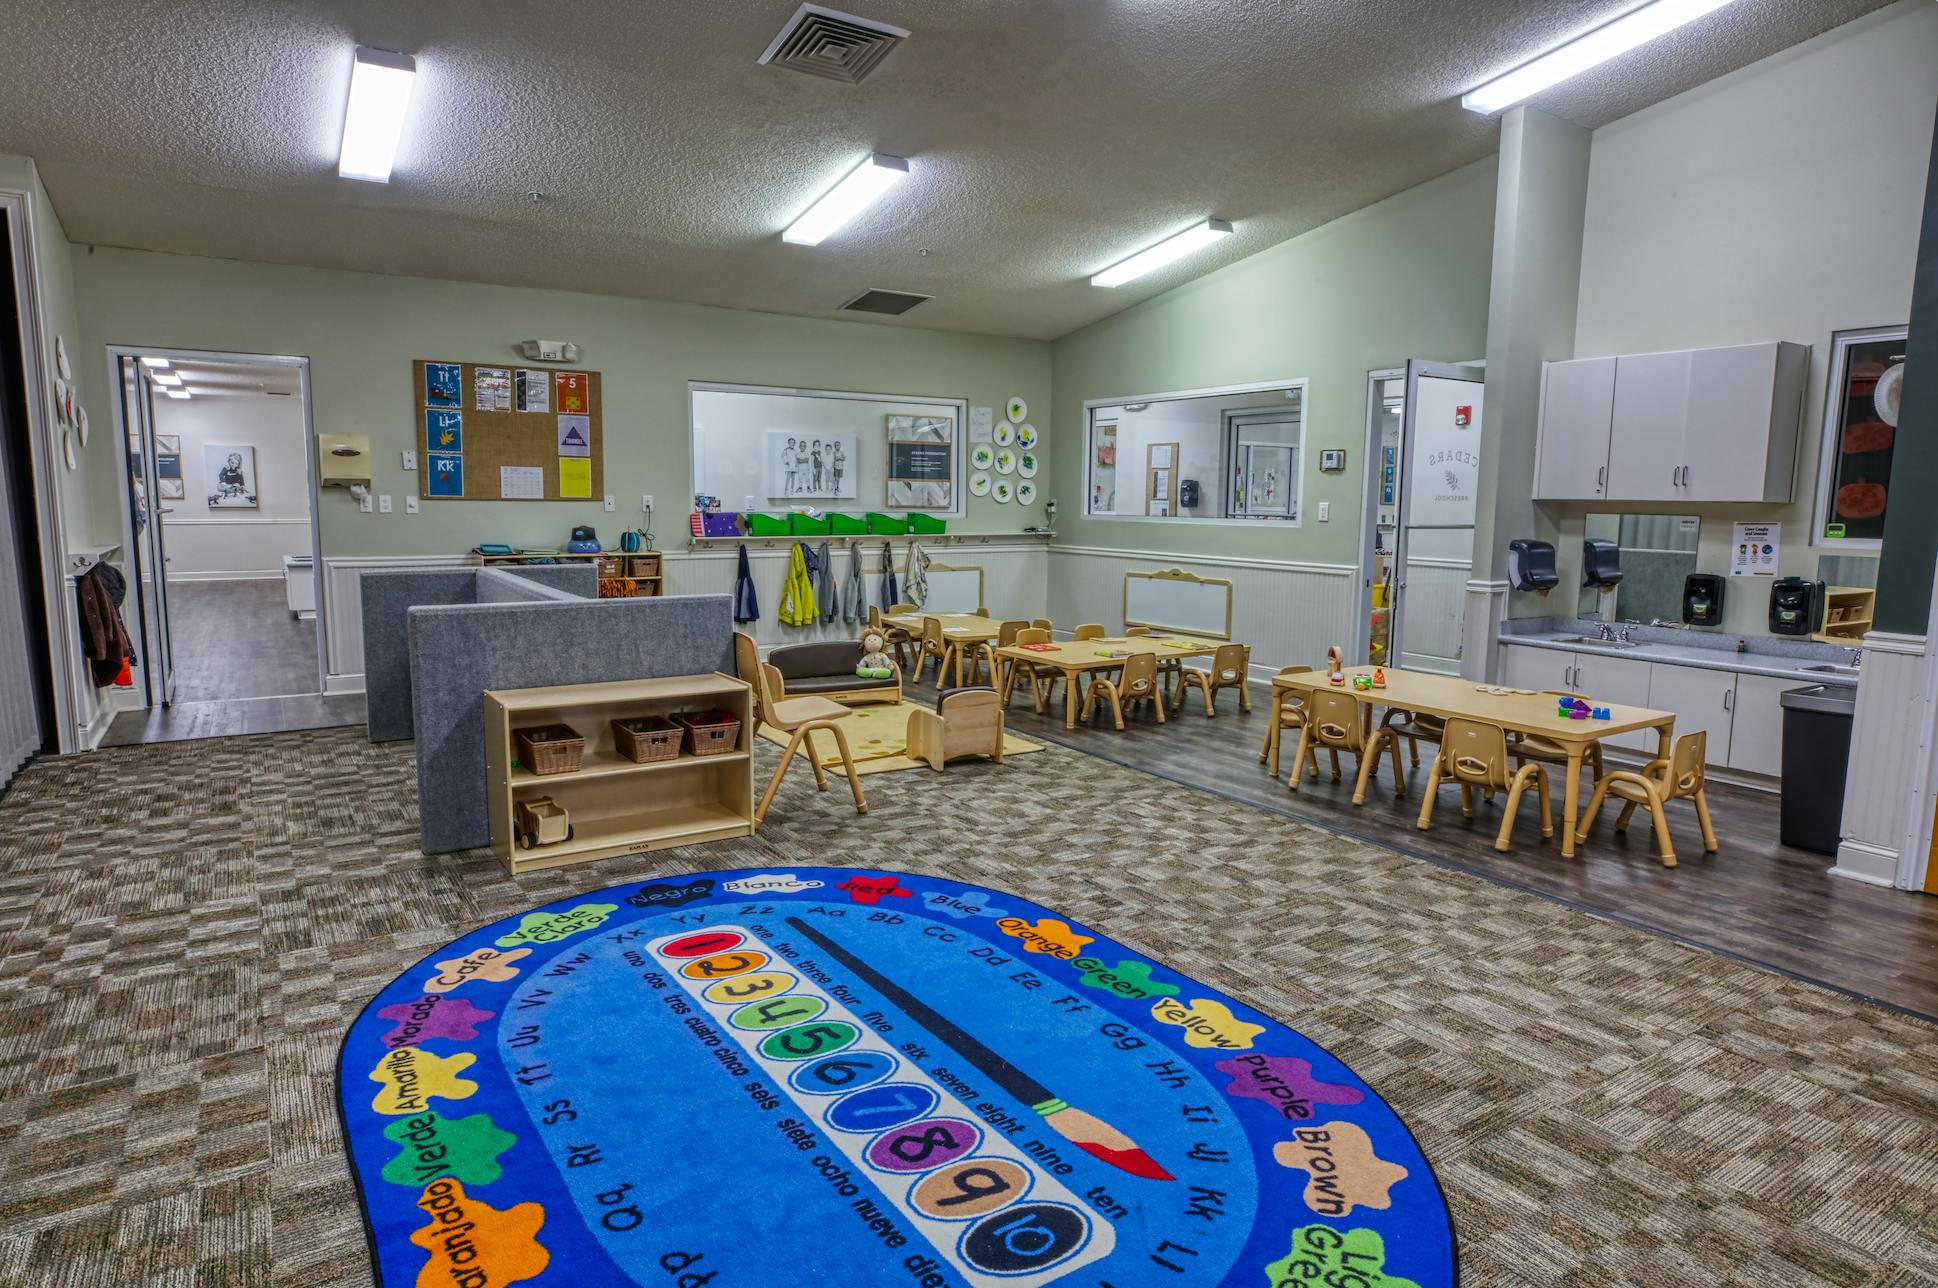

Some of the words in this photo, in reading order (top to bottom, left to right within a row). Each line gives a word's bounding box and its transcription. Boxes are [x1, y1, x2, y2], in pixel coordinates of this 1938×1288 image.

[438, 371, 449, 382] Tt
[569, 378, 576, 388] 5
[630, 886, 707, 905] Negro
[725, 879, 822, 891] Blanco
[843, 882, 896, 895] Red
[739, 906, 775, 915] Zz
[806, 906, 846, 917] Aa
[930, 895, 982, 914] Blue
[503, 911, 592, 939] Verde
[670, 914, 706, 924] Yy
[867, 913, 904, 925] Bb
[606, 928, 646, 944] Xx
[681, 938, 725, 950] 1
[923, 926, 958, 942] Cc
[998, 919, 1073, 960] Orange
[543, 953, 593, 977] Ww
[697, 956, 750, 976] 2
[967, 947, 1013, 965] Dd
[436, 952, 502, 986] Cafe
[1009, 971, 1042, 991] Ee
[1072, 957, 1147, 999] Green
[517, 989, 552, 1010] Vv
[724, 979, 774, 996] 3
[758, 1000, 808, 1024] 4
[1051, 995, 1092, 1013] Ff
[390, 995, 442, 1049] Morado
[1153, 999, 1241, 1049] Yellow
[507, 1024, 541, 1048] Uu
[781, 1027, 842, 1054] 5
[1101, 1023, 1146, 1050] Gg
[387, 1049, 423, 1110] Amarillo
[515, 1063, 552, 1086] Tt
[750, 924, 774, 939] one
[774, 943, 800, 959] two
[797, 960, 833, 984] three
[829, 985, 863, 1005] four
[862, 1011, 893, 1033] five
[901, 1042, 930, 1060] six
[931, 1067, 980, 1100] seven
[976, 1102, 1026, 1135] eight
[1023, 1140, 1073, 1175] nine
[1085, 1186, 1128, 1219] ten
[814, 1060, 874, 1085] 6
[1145, 1060, 1192, 1089] Hh
[1236, 1055, 1310, 1120] Purple
[542, 1099, 577, 1125] Ss
[852, 1093, 917, 1116] 7
[1183, 1104, 1219, 1124] Ii
[623, 950, 646, 967] uno
[643, 972, 667, 990] dos
[664, 994, 691, 1015] tres
[684, 1017, 721, 1047] cuatro
[714, 1048, 749, 1077] cinco
[744, 1082, 780, 1111] seis
[777, 1118, 817, 1151] siete
[812, 1155, 859, 1196] ocho
[851, 1198, 907, 1248] nueve
[903, 1255, 951, 1288] die
[400, 1113, 451, 1182] Verde
[566, 1143, 604, 1168] Rr
[889, 1126, 960, 1162] 8
[1186, 1142, 1230, 1163] Jj
[1295, 1129, 1346, 1216] Brown
[936, 1167, 1011, 1206] 9
[595, 1183, 643, 1232] Qq
[1184, 1185, 1227, 1221] Kk
[992, 1213, 1056, 1257] 10
